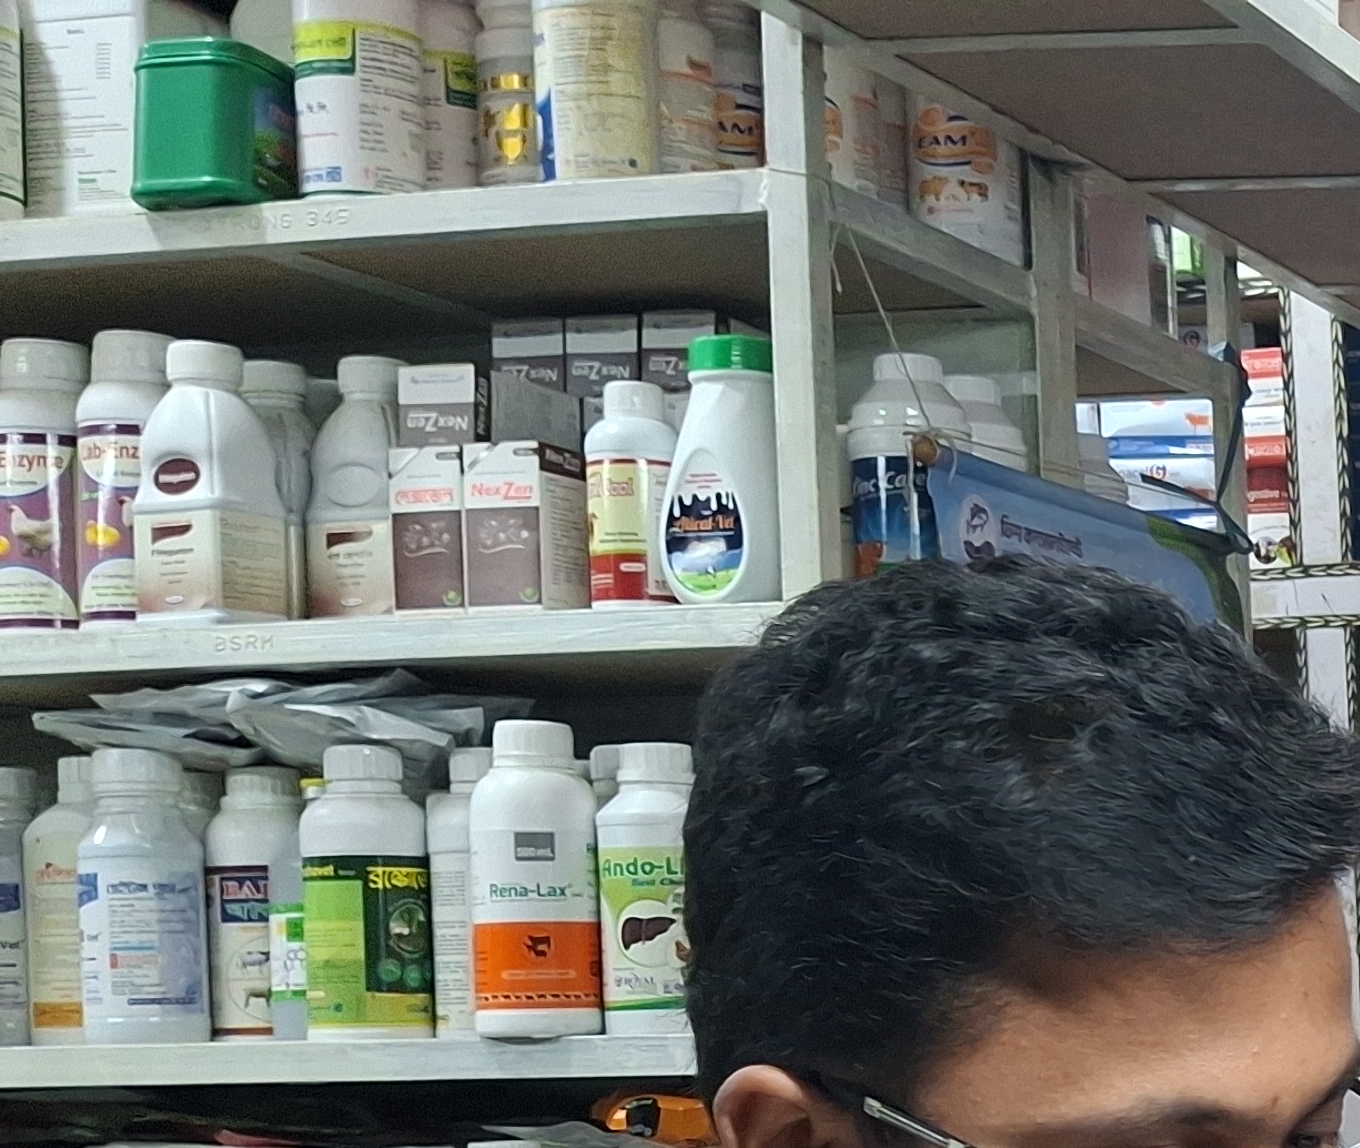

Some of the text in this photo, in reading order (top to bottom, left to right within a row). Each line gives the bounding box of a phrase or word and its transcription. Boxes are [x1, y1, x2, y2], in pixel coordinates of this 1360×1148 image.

[406, 410, 470, 433] NexZen
[470, 482, 535, 502] NexZen
[489, 881, 568, 901] Rena-Lax
